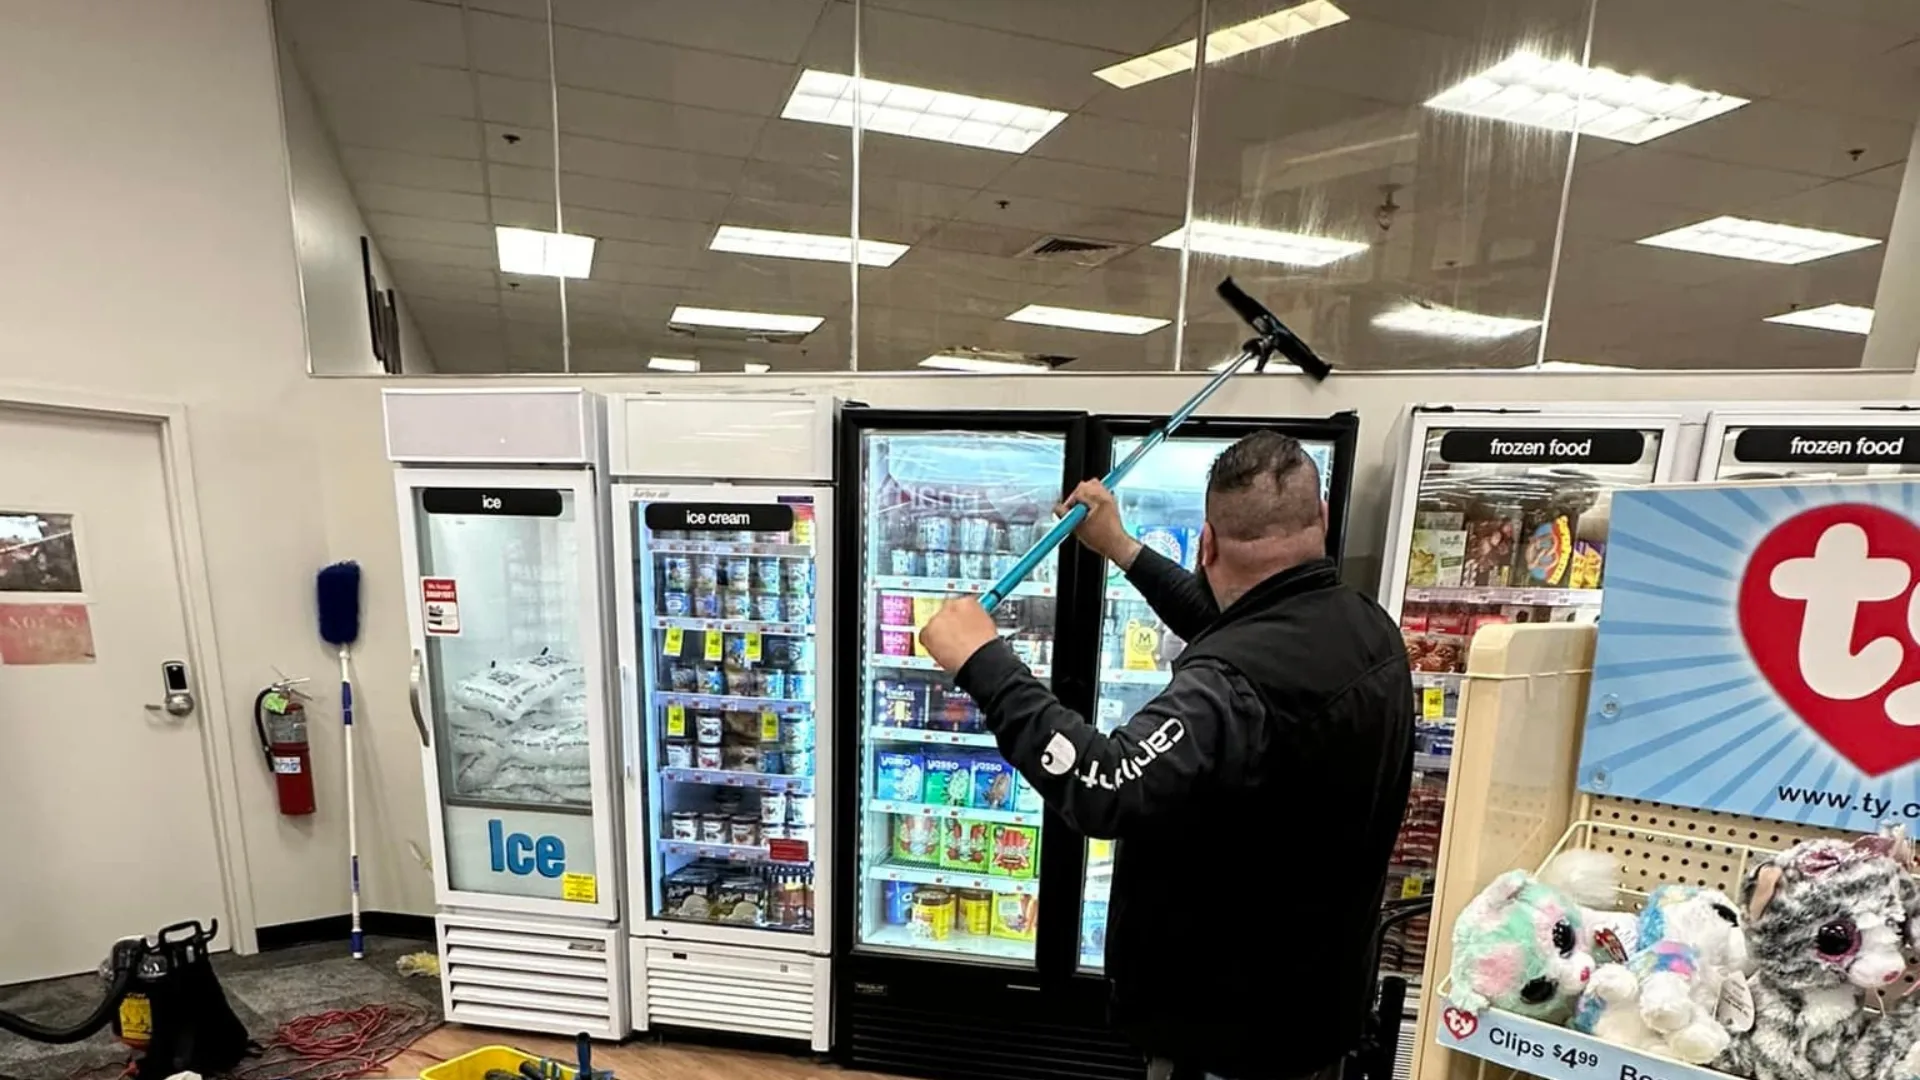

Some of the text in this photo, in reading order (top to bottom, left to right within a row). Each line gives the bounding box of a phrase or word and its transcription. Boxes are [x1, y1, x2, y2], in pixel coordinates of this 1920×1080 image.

[1490, 437, 1592, 456] frozen food
[1790, 436, 1904, 455] frozen food
[481, 494, 502, 509] ice
[686, 510, 750, 525] ice cream
[927, 760, 959, 770] yasso
[488, 818, 566, 878] Ice
[1446, 1009, 1477, 1035] ty
[1489, 1027, 1545, 1059] Clips
